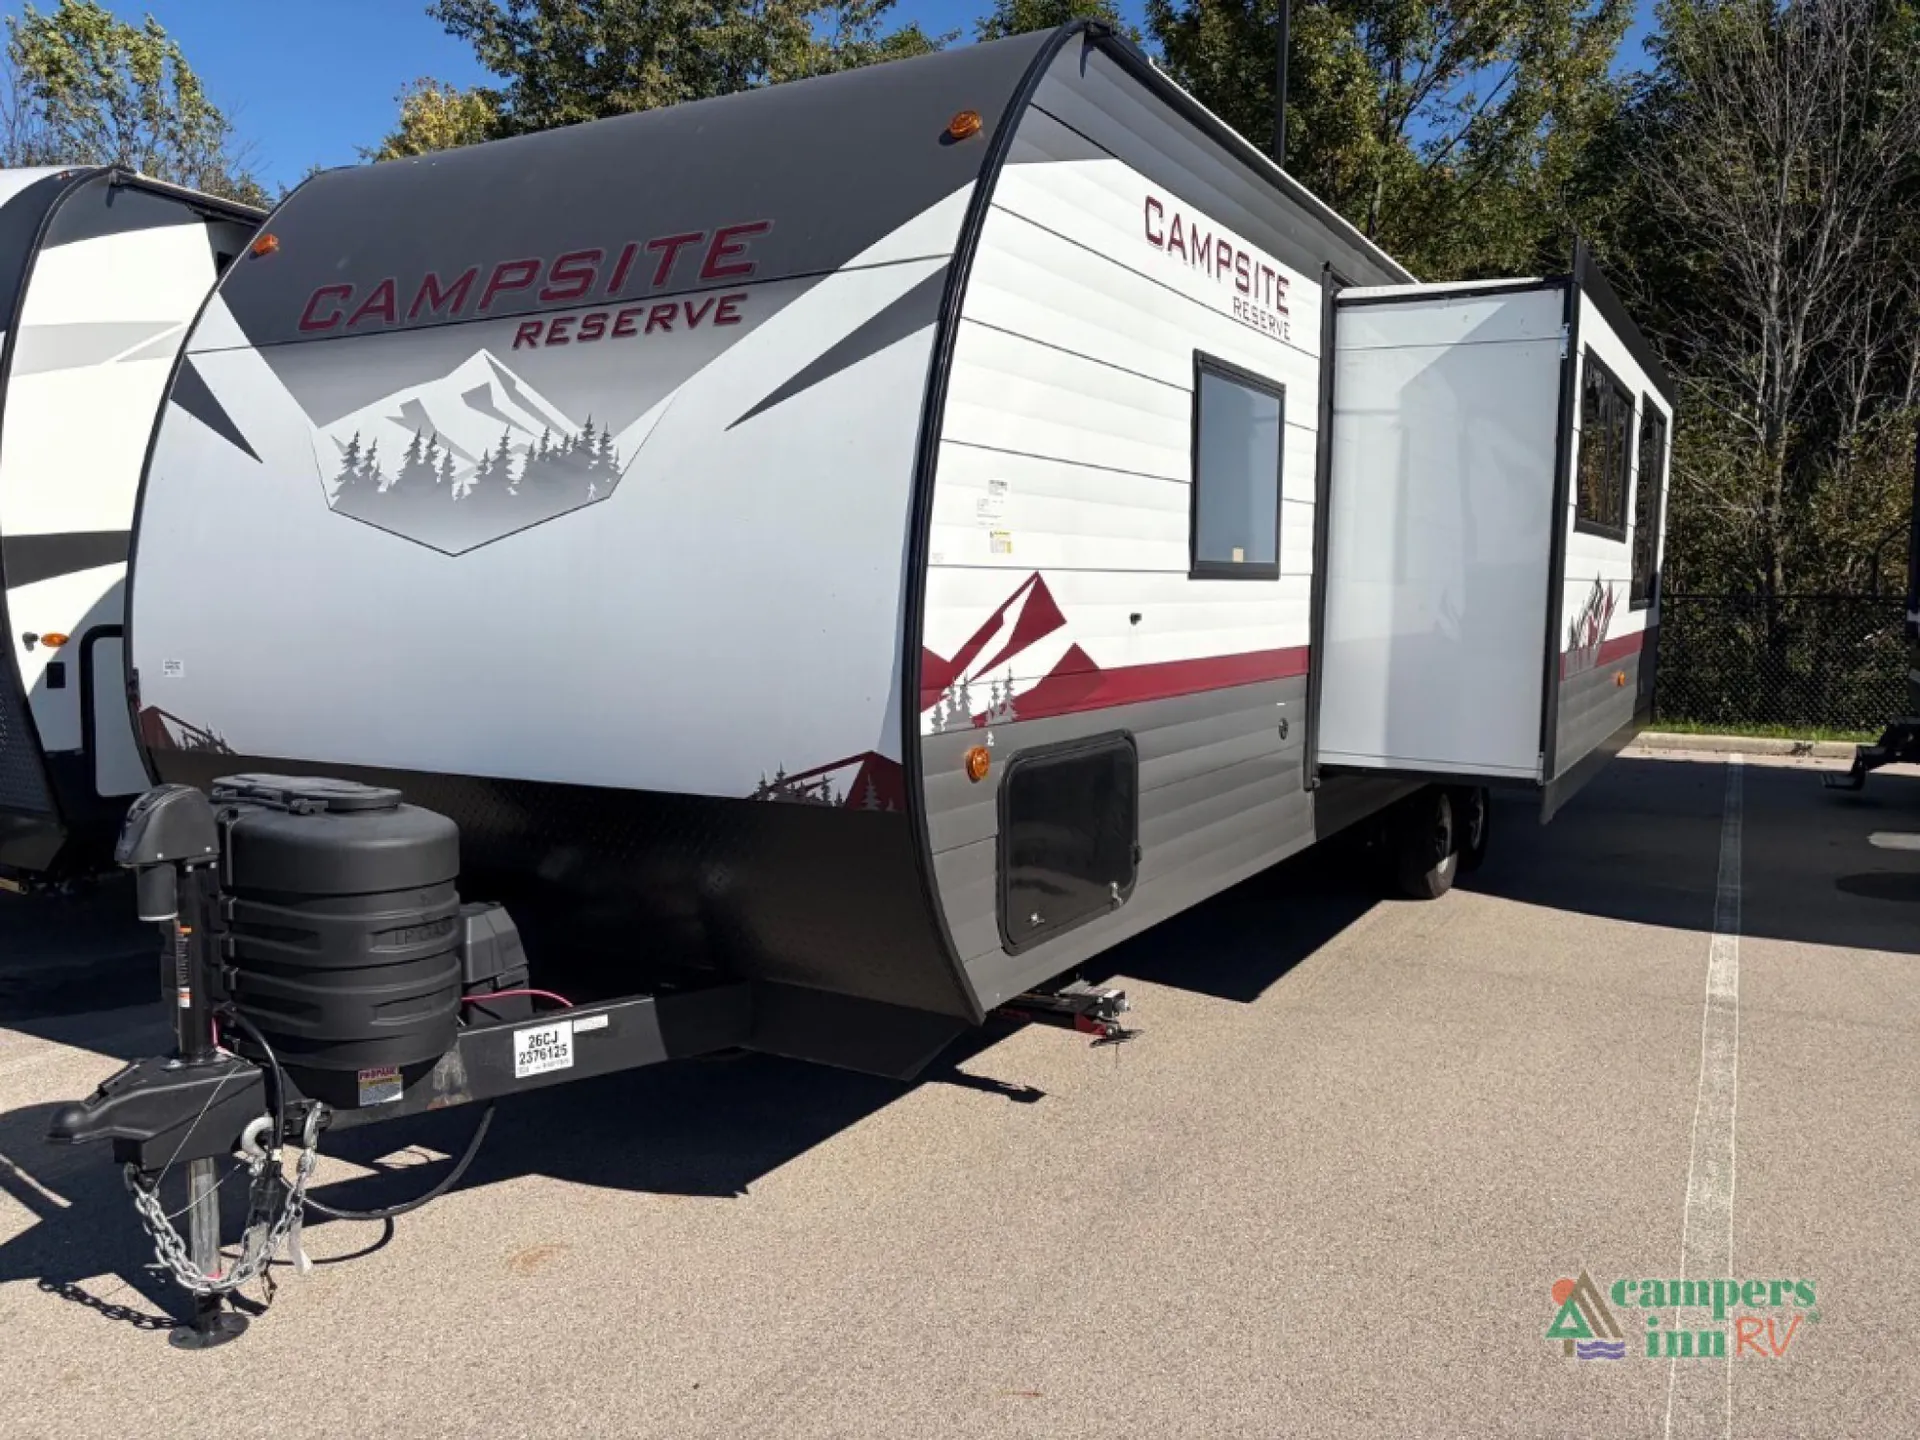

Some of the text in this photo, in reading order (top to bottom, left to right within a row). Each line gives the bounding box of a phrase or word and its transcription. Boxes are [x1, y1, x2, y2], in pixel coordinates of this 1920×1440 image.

[298, 219, 773, 332] CAMPSITE
[1144, 195, 1291, 316] CAMPSITE
[512, 292, 748, 350] RESERVE
[1232, 296, 1291, 341] RESERVE
[519, 1044, 568, 1066] 2376125
[528, 1030, 558, 1049] 26CJ
